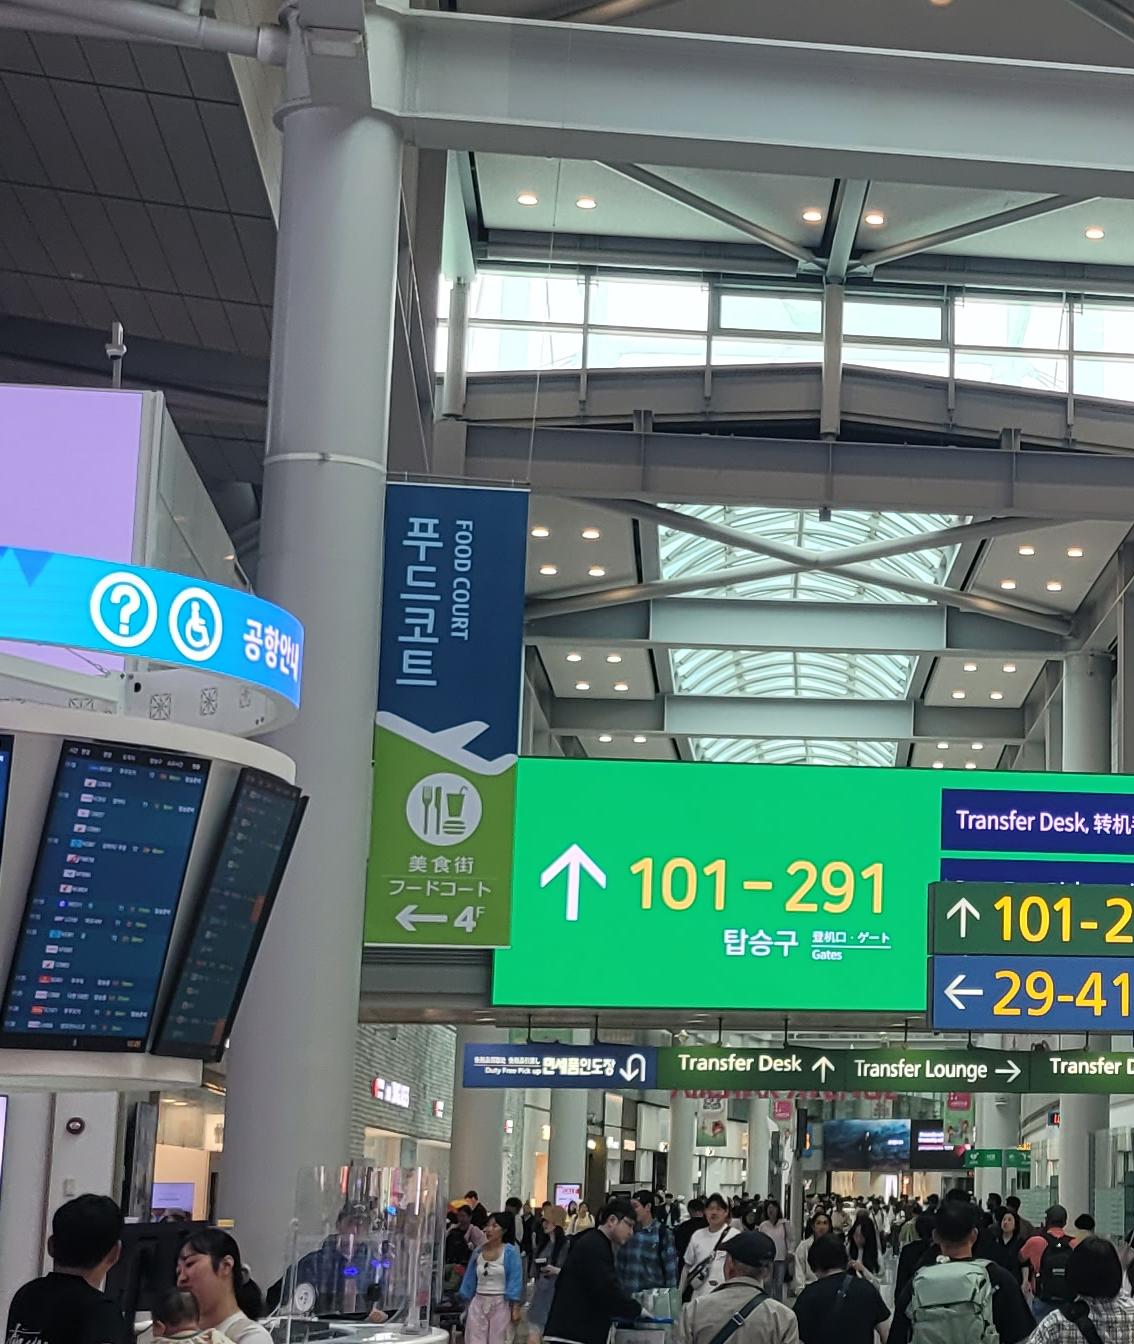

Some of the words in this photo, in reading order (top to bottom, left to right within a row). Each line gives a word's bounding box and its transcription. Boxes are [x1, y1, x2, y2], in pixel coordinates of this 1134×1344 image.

[453, 520, 473, 571] FOOD
[396, 517, 443, 686] 푸드코트
[450, 577, 471, 641] COURT
[956, 809, 1036, 832] Transfer
[1040, 812, 1090, 835] Desk,
[408, 855, 474, 874] 美食街
[389, 880, 491, 898] フードコート
[724, 928, 799, 957] 탑승구
[811, 949, 843, 961] Gates
[993, 970, 1129, 1016] 29-41
[484, 1066, 501, 1076] Duty
[678, 1054, 755, 1072] Transfer
[758, 1054, 802, 1073] Desk
[854, 1058, 922, 1079] Transfer
[925, 1059, 988, 1083] Lounge
[1049, 1057, 1121, 1075] Transfer
